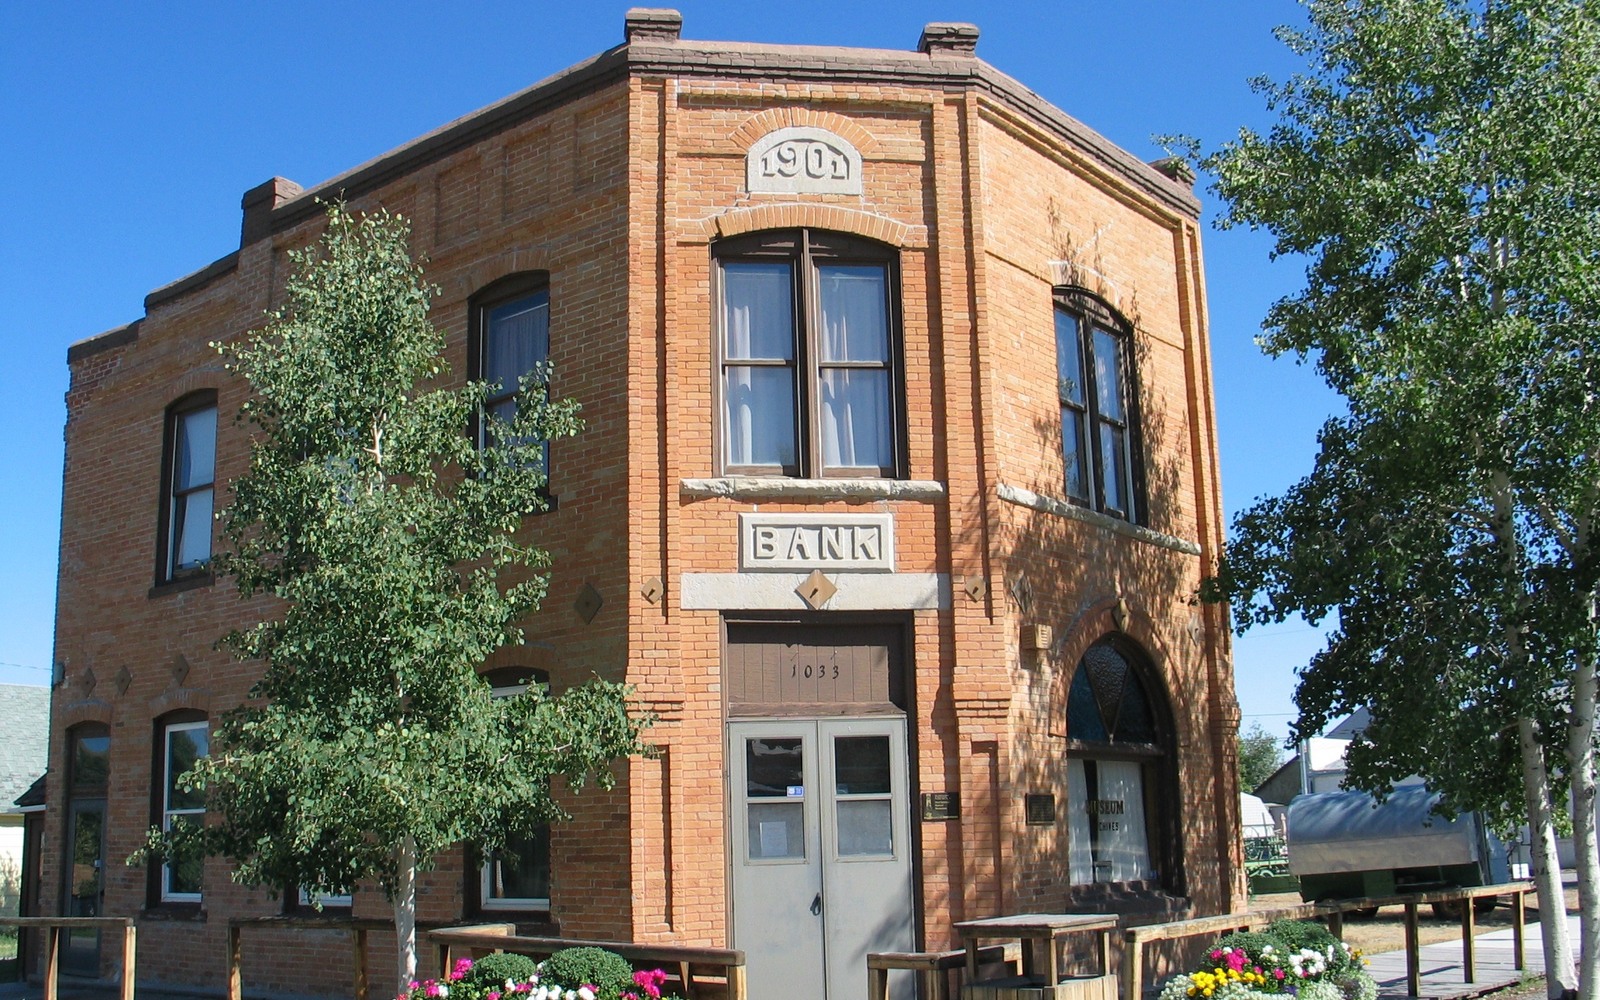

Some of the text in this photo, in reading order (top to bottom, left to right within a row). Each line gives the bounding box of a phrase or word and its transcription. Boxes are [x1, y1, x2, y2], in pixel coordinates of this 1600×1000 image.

[760, 140, 846, 180] 1901
[753, 526, 878, 560] BANK
[791, 664, 839, 679] 1033
[1085, 800, 1124, 814] MUSEUM
